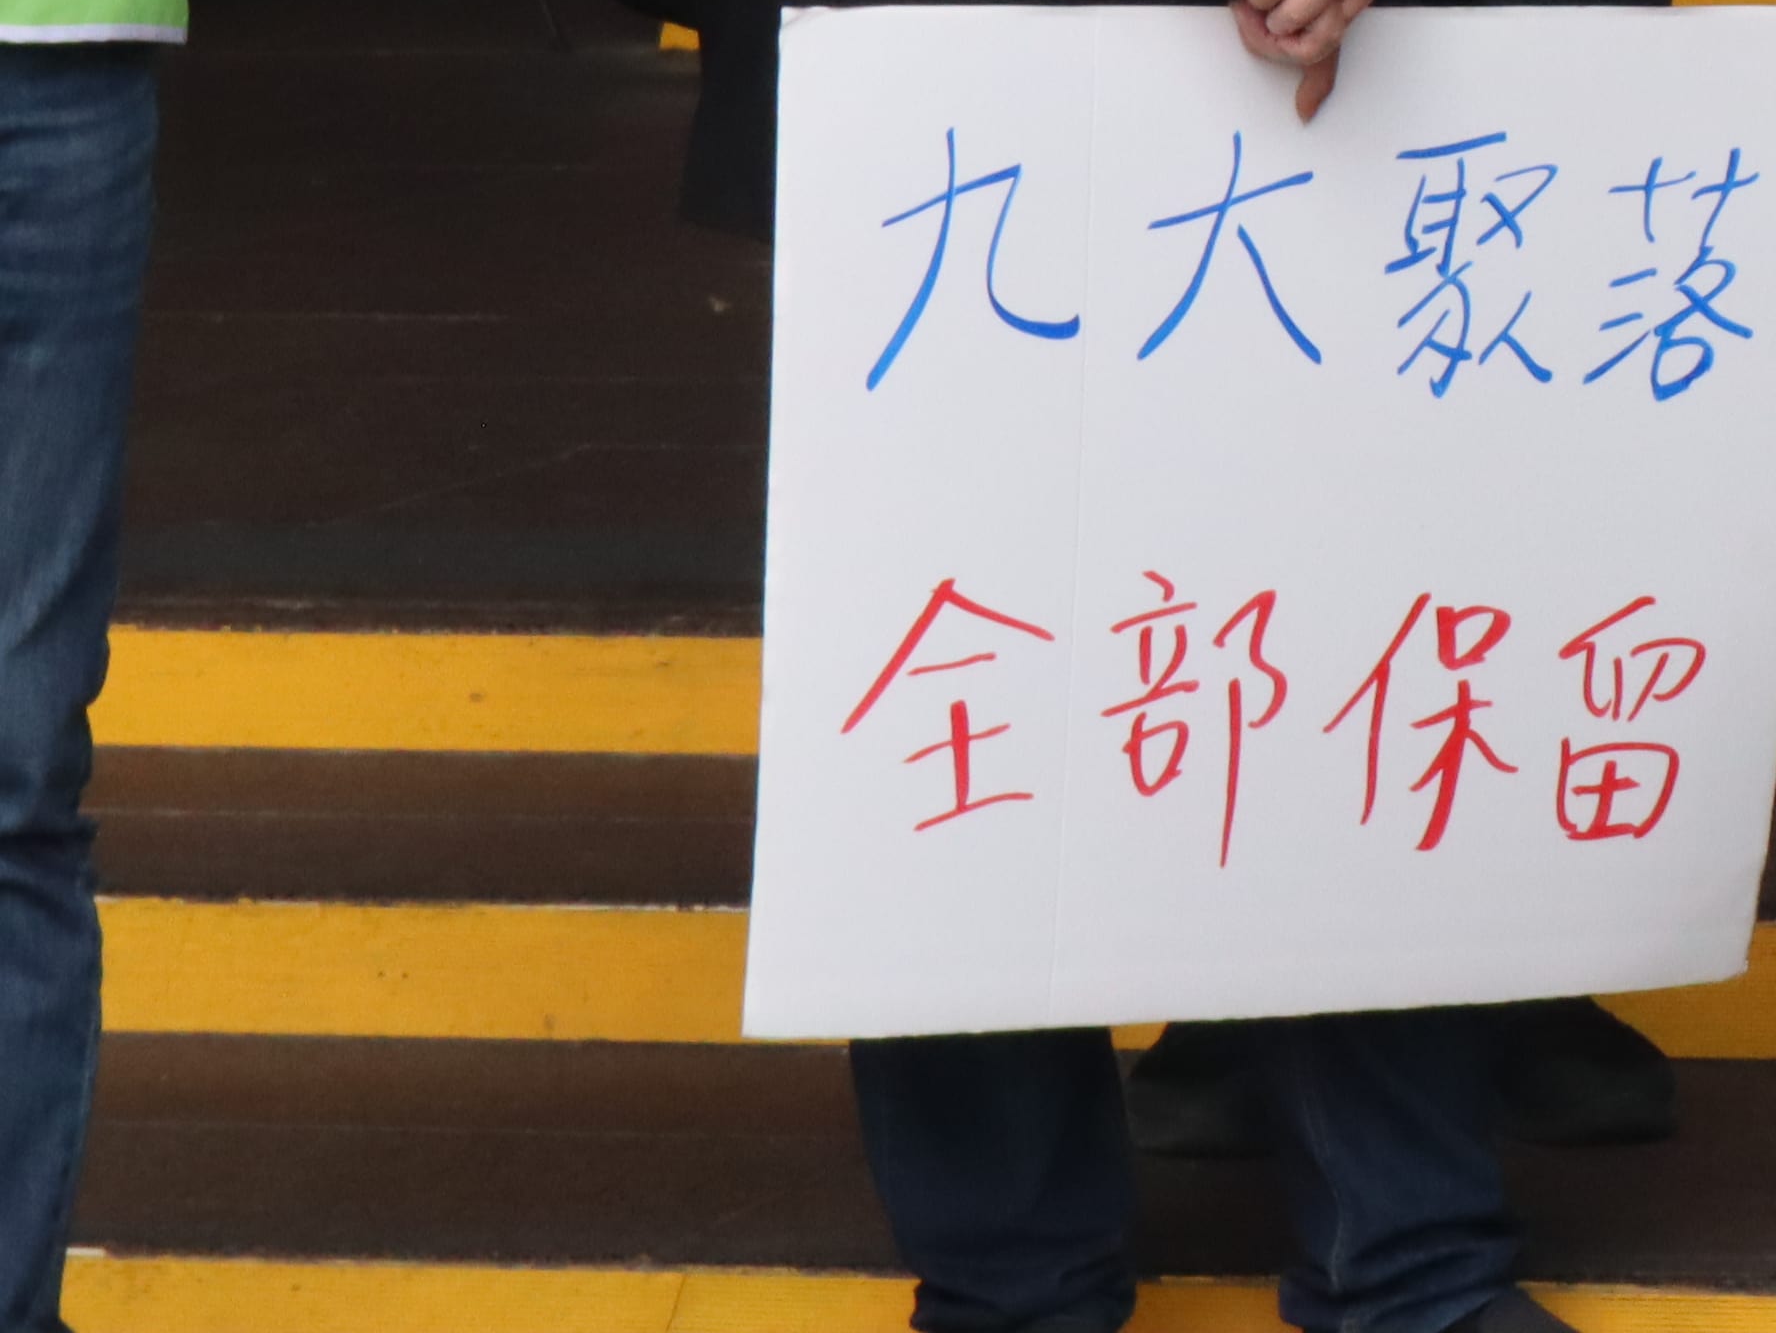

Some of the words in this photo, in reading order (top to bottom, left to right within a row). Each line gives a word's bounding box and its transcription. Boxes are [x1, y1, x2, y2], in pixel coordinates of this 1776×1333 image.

[867, 127, 1761, 401] 九大聚落
[840, 570, 1704, 868] 全部保留
